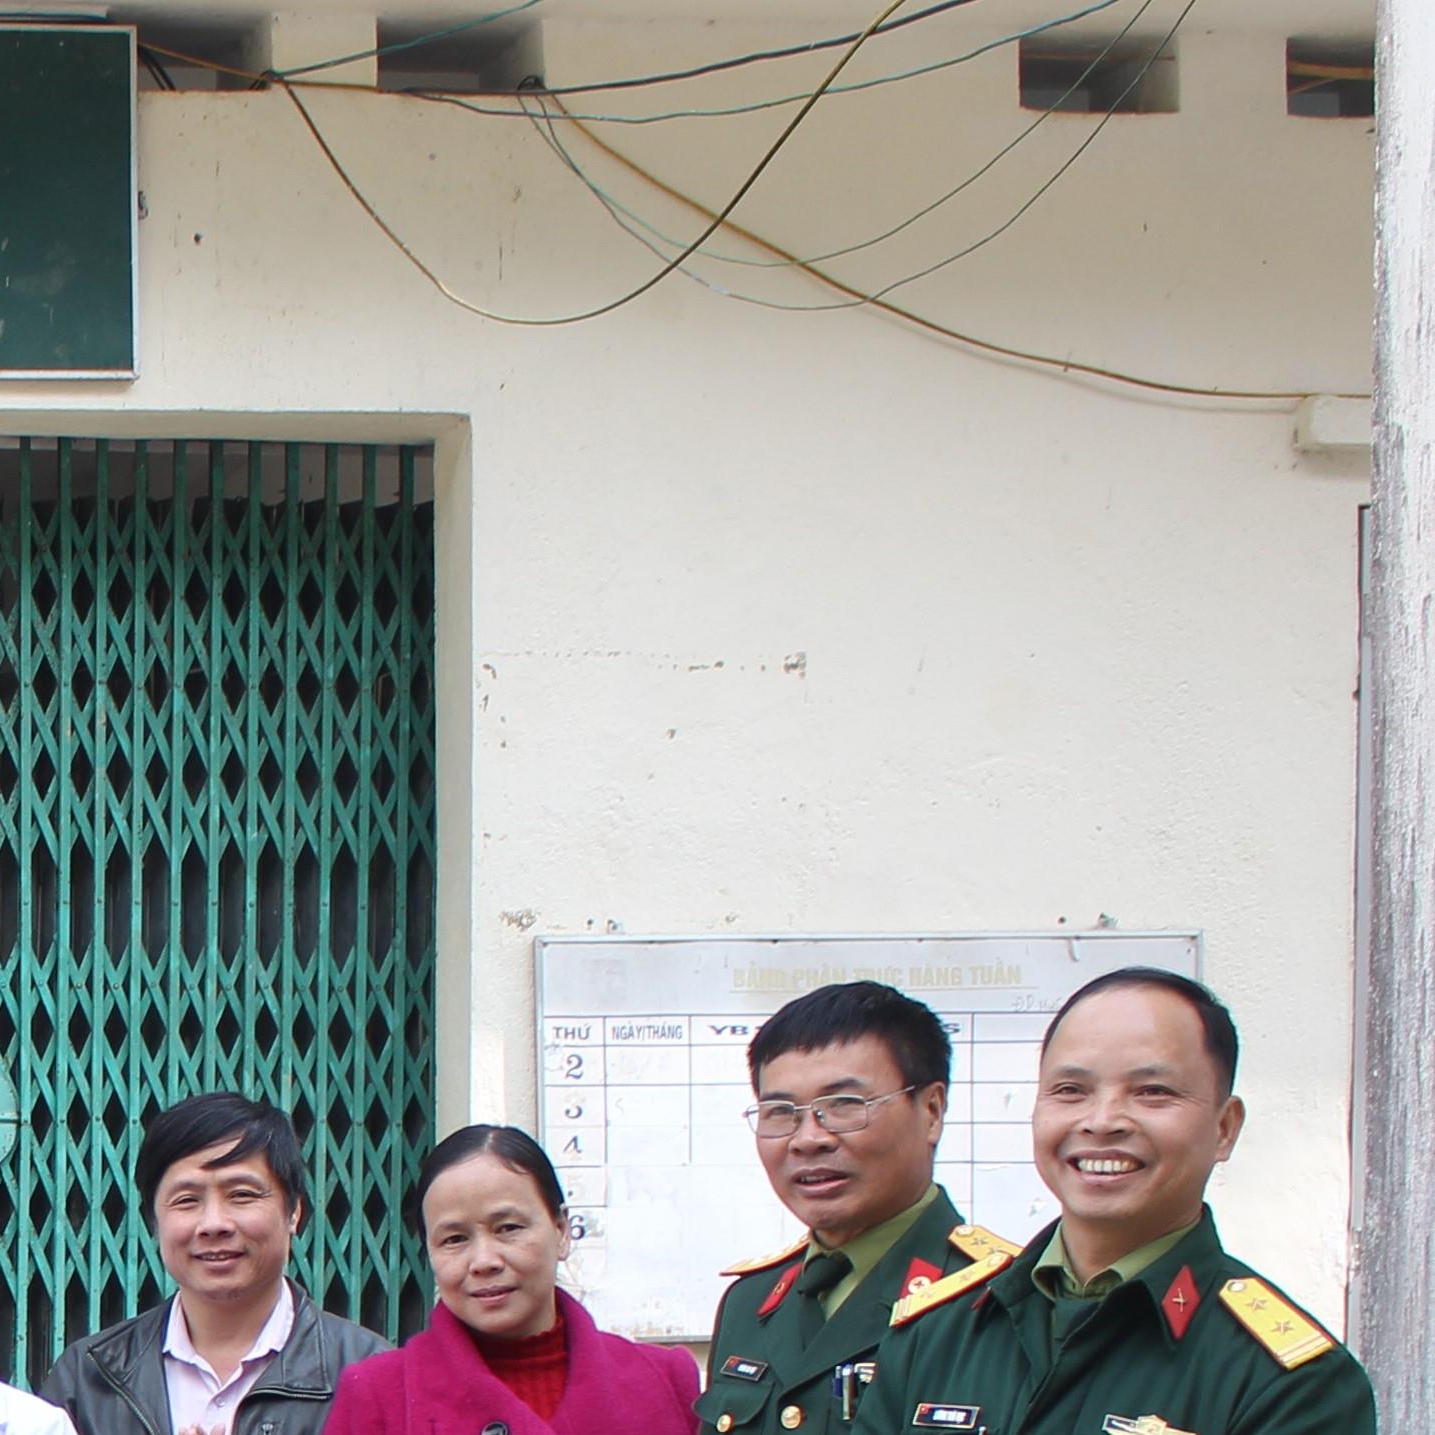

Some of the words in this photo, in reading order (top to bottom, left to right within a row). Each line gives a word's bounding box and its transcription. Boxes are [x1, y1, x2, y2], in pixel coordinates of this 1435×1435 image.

[553, 1022, 592, 1041] THỨ
[612, 1022, 683, 1041] NGÀY/THÁNG
[566, 1054, 584, 1079] 2
[569, 1214, 586, 1240] 6
